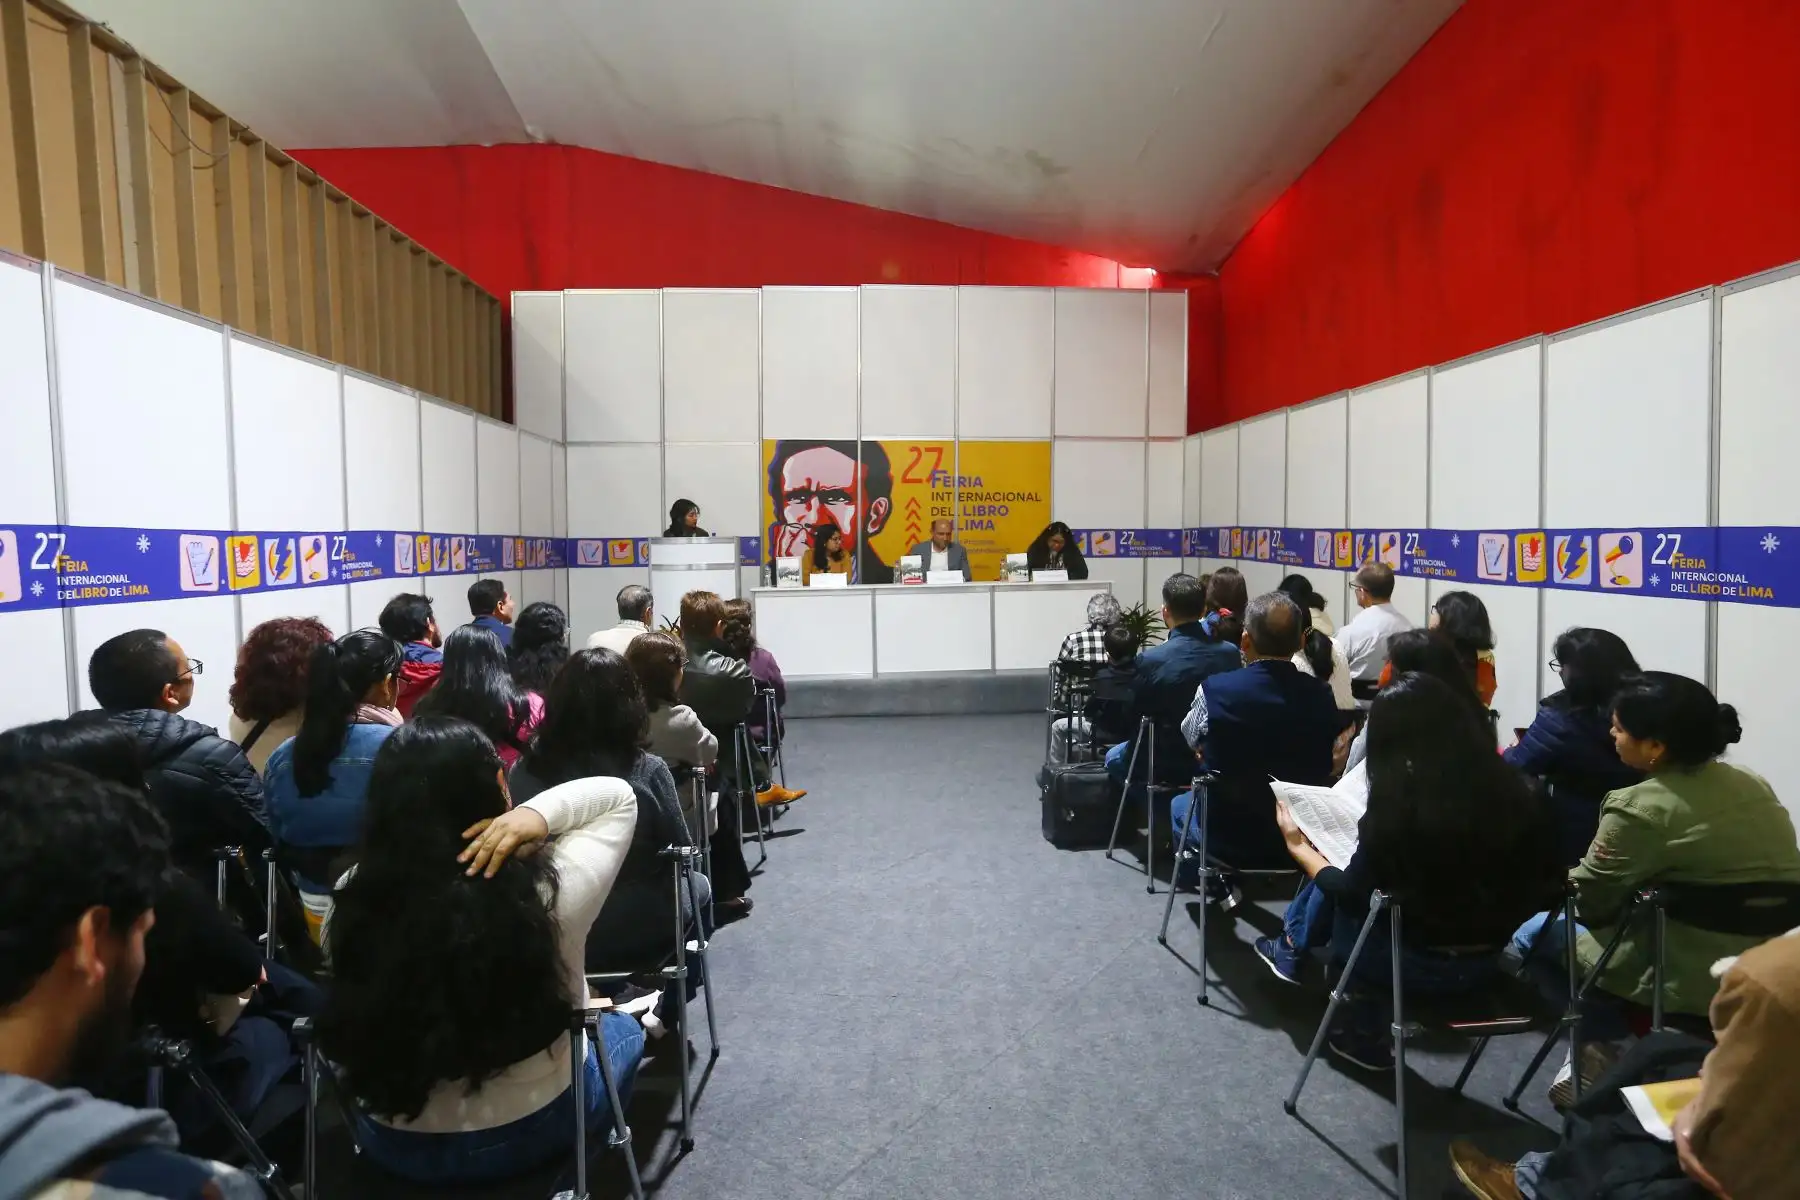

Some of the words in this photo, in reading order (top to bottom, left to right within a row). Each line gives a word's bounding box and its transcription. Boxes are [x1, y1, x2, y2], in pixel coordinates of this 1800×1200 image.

[901, 446, 944, 484] 27
[931, 491, 1042, 502] INTERNACIONAL
[963, 505, 1009, 517] LIBRO
[1120, 531, 1135, 545] 27
[1271, 530, 1281, 547] 27
[1404, 532, 1419, 555] 27
[30, 532, 66, 569] 27
[331, 535, 347, 561] 27
[467, 538, 476, 556] 27
[1651, 533, 1681, 565] 27
[1671, 553, 1706, 569] FERIA
[56, 574, 131, 586] INTERNACIONAL
[73, 586, 108, 599] LIBRO
[109, 587, 122, 597] DE
[122, 584, 150, 596] LIMA
[1670, 583, 1689, 593] DEL
[1722, 586, 1737, 596] DE
[1738, 586, 1774, 598] LIMA
